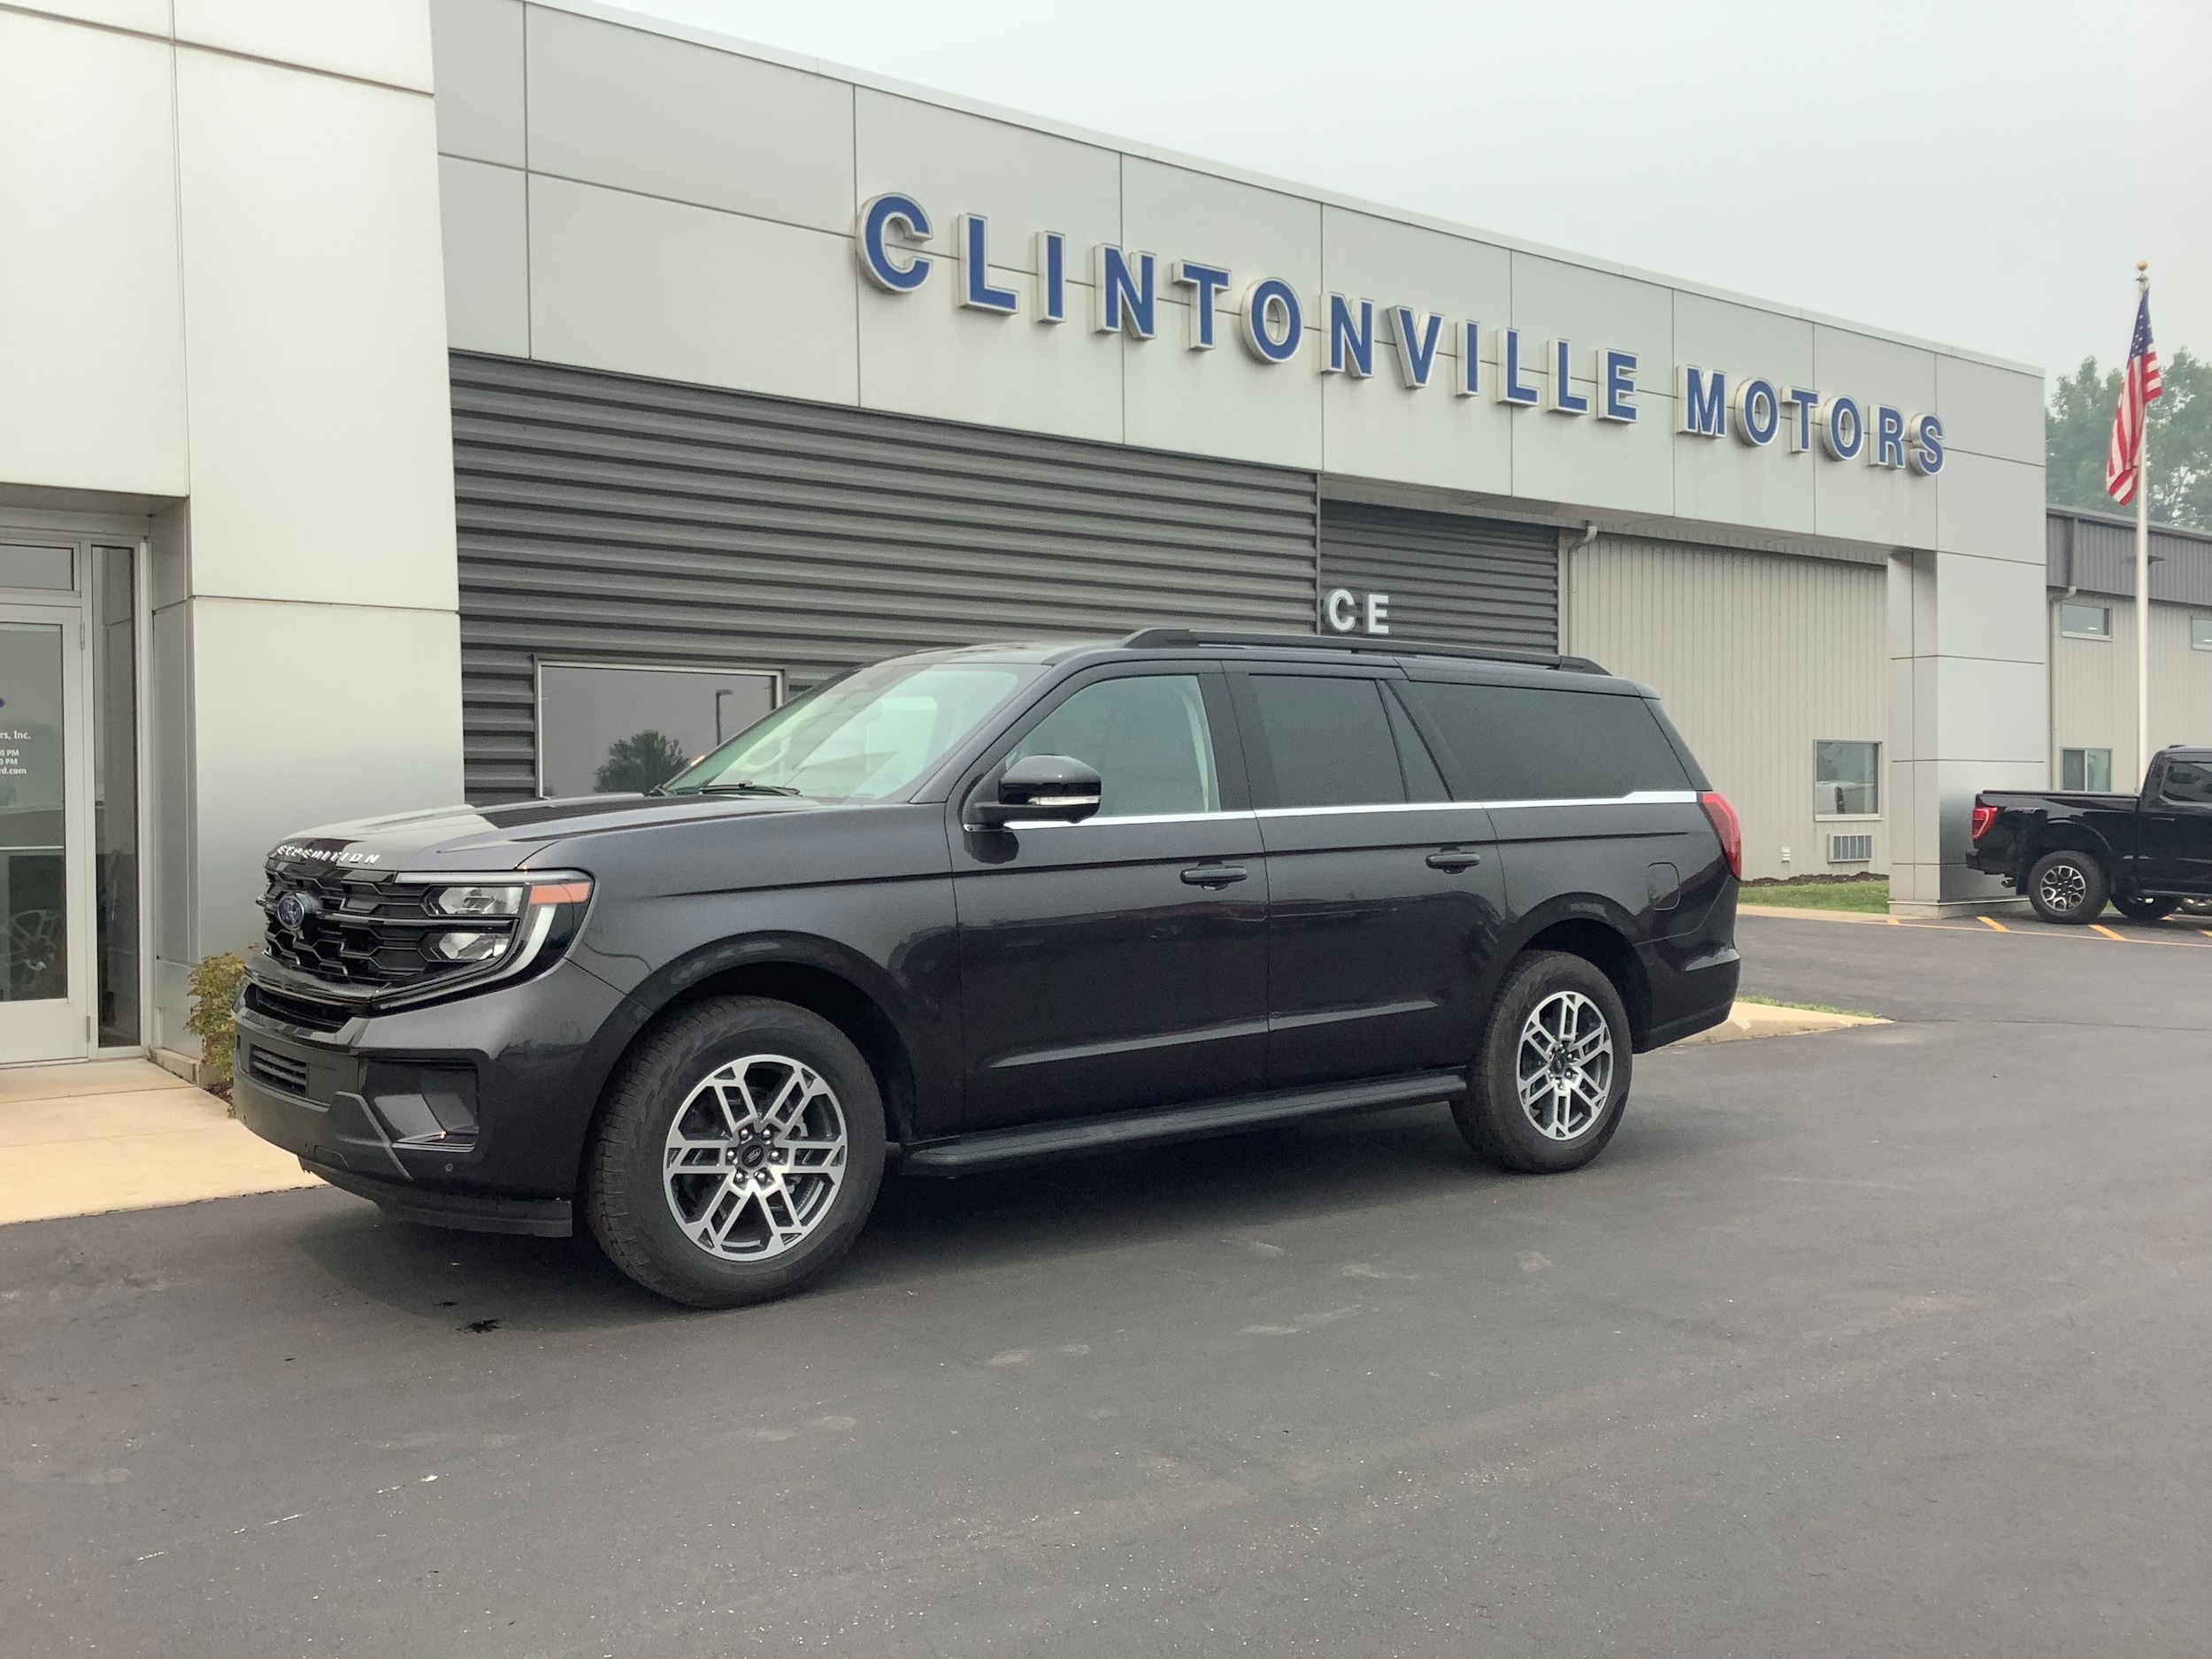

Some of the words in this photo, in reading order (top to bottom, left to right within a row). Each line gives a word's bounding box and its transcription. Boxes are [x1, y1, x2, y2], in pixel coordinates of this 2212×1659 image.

[856, 192, 1638, 423] CLINTONVILLE
[1677, 365, 1944, 475] MOTORS
[13, 730, 32, 740] Inc.
